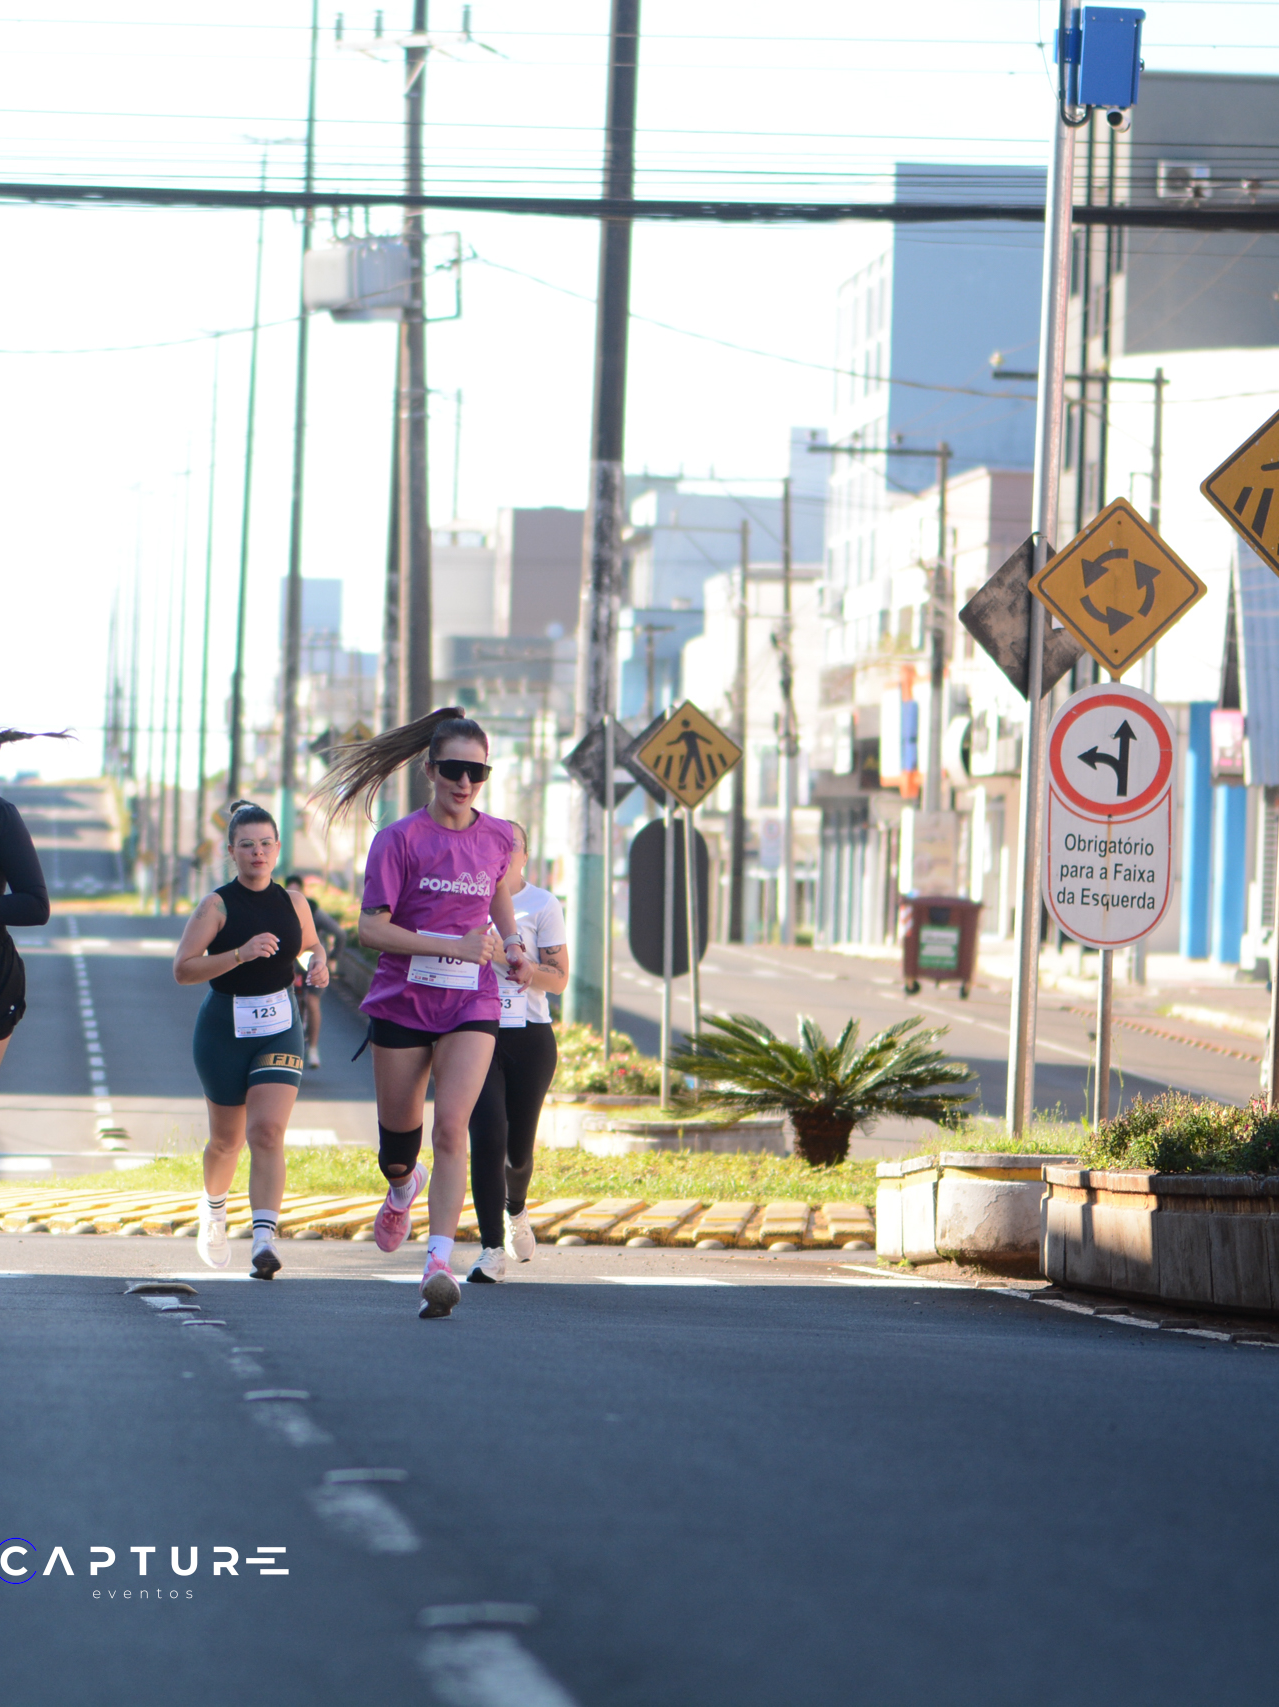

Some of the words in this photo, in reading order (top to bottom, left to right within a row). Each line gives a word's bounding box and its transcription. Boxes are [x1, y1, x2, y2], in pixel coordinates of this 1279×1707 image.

[1064, 833, 1154, 858] Obrigatório
[1060, 863, 1094, 882] para
[1099, 866, 1108, 880] a
[1114, 863, 1155, 883] Faixa
[419, 877, 491, 896] PODEROSA
[1056, 886, 1075, 905] da
[1081, 887, 1155, 911] Esquerda
[252, 1006, 277, 1019] 123
